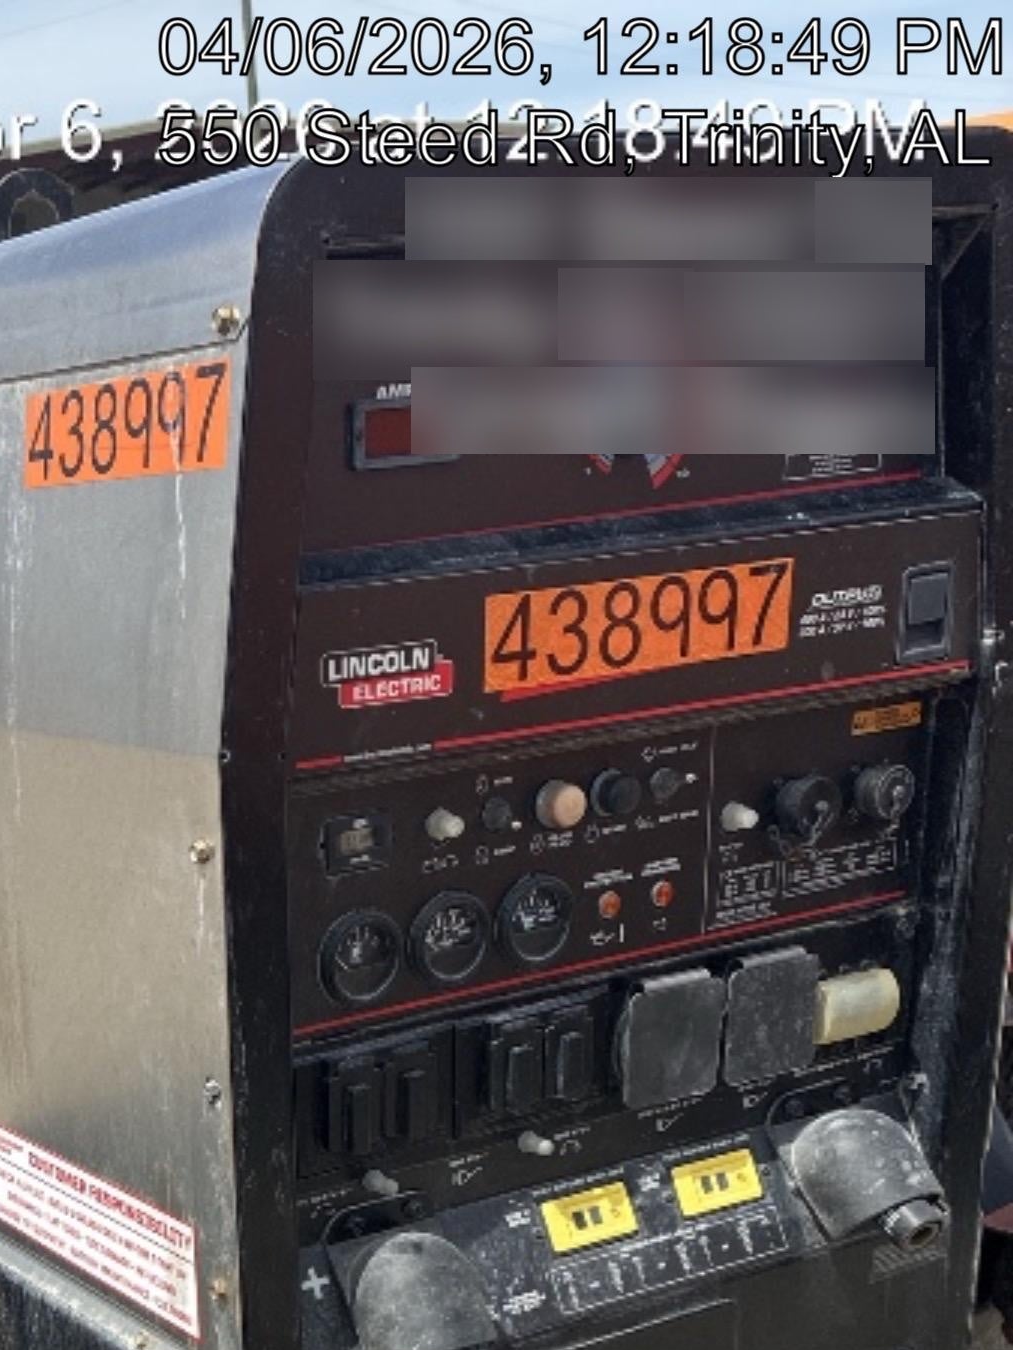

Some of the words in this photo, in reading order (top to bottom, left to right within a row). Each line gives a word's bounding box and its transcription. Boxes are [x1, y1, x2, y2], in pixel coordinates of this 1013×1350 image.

[28, 362, 227, 480] 438997
[492, 562, 790, 684] 438997
[328, 646, 430, 681] LINCOLN
[352, 674, 442, 702] ELECTRIC
